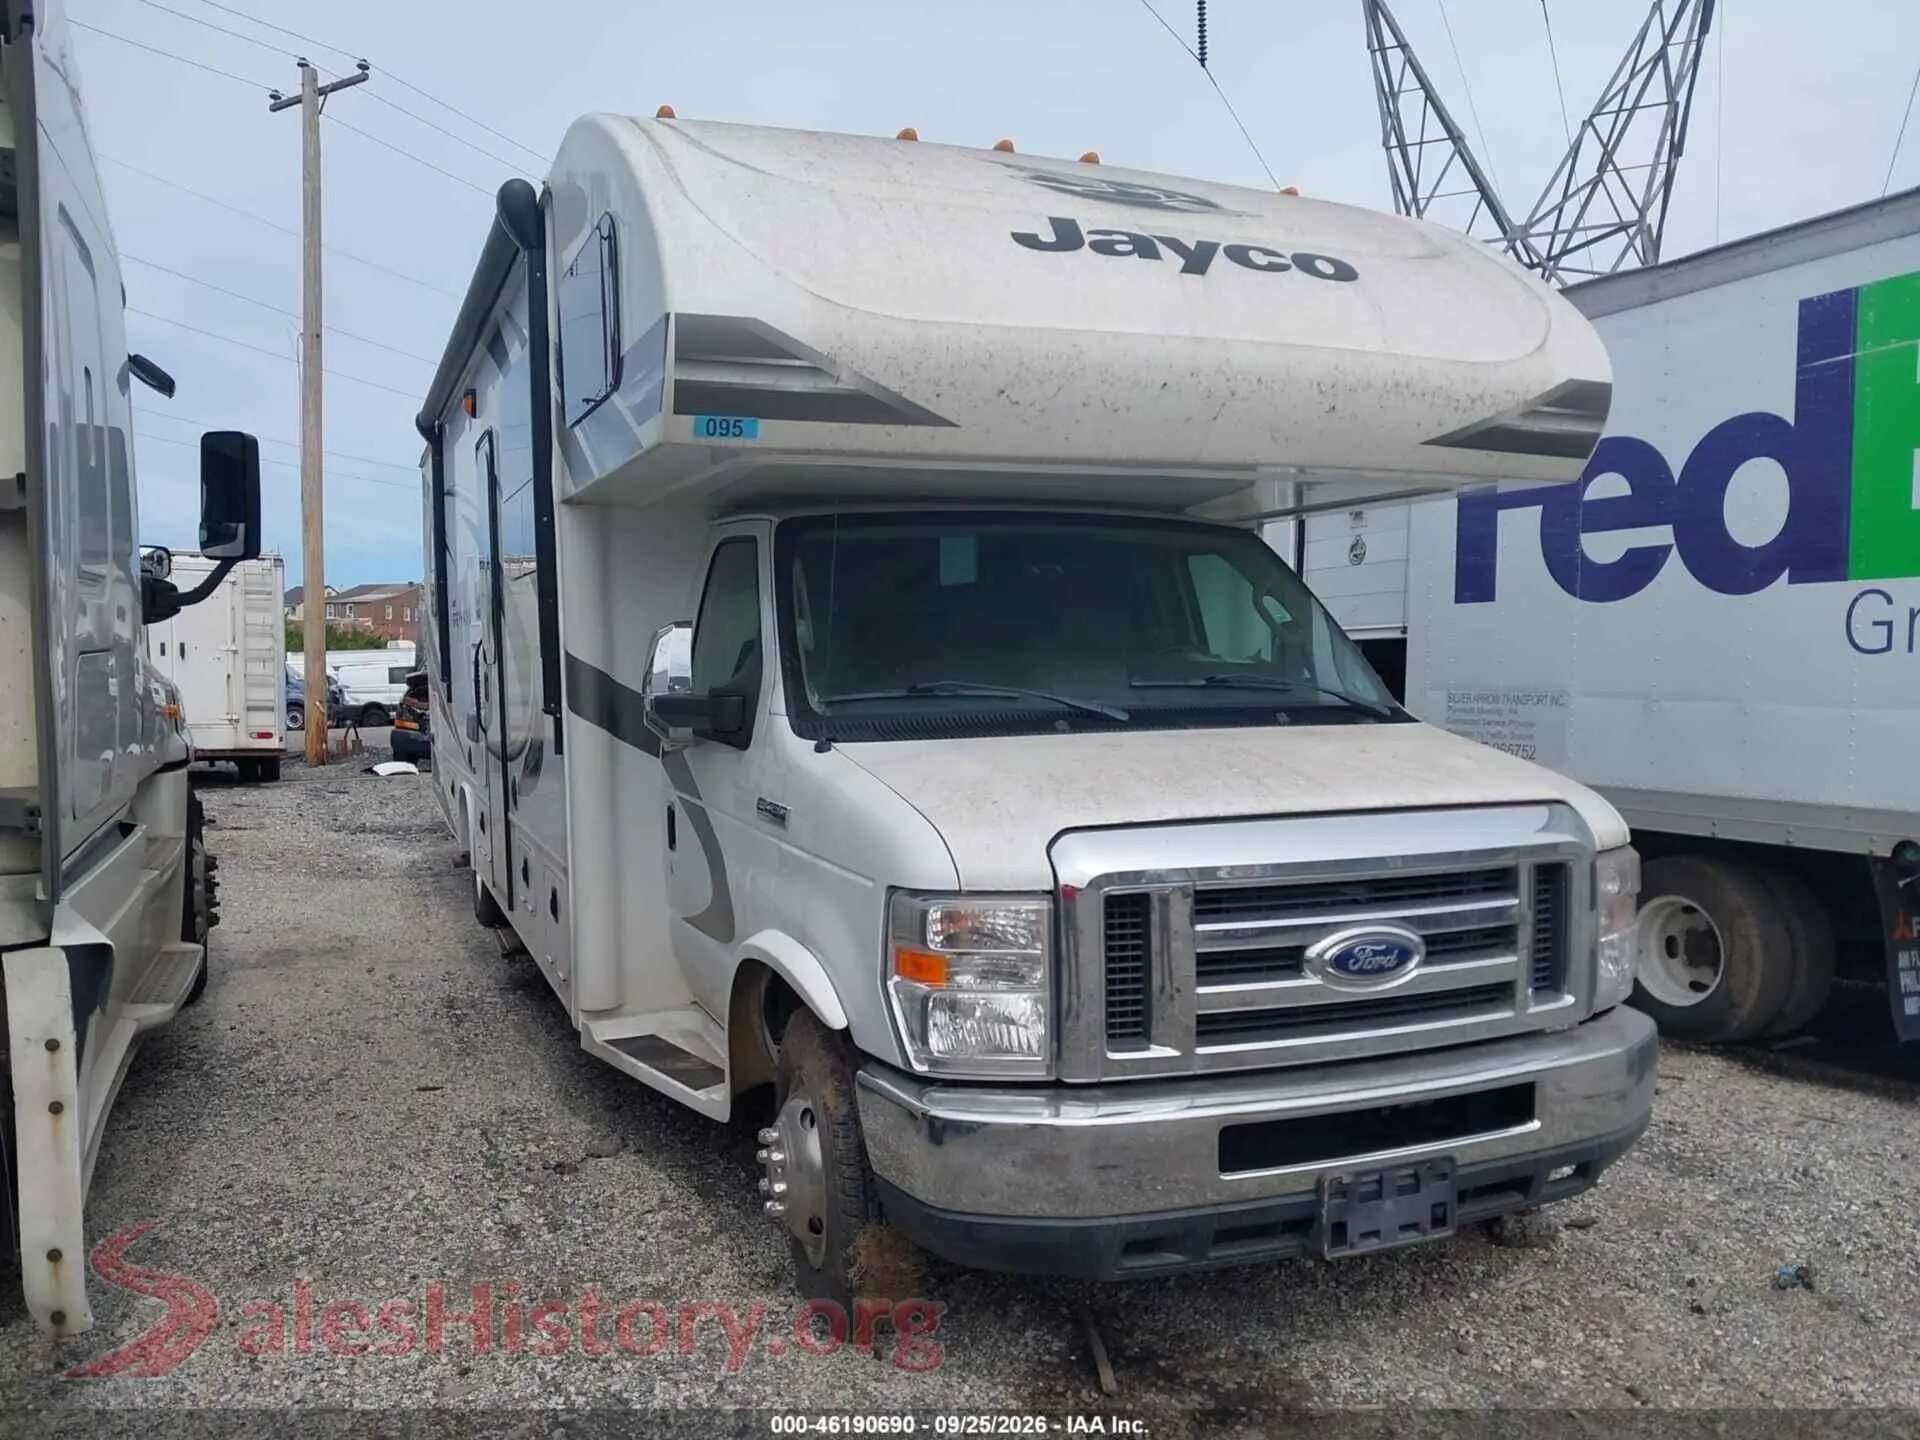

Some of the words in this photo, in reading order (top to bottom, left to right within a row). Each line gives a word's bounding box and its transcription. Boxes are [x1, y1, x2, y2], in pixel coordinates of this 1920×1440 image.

[1010, 216, 1359, 282] Jayco
[706, 418, 744, 437] 095
[1845, 588, 1920, 655] Gr
[1348, 944, 1398, 970] Ford
